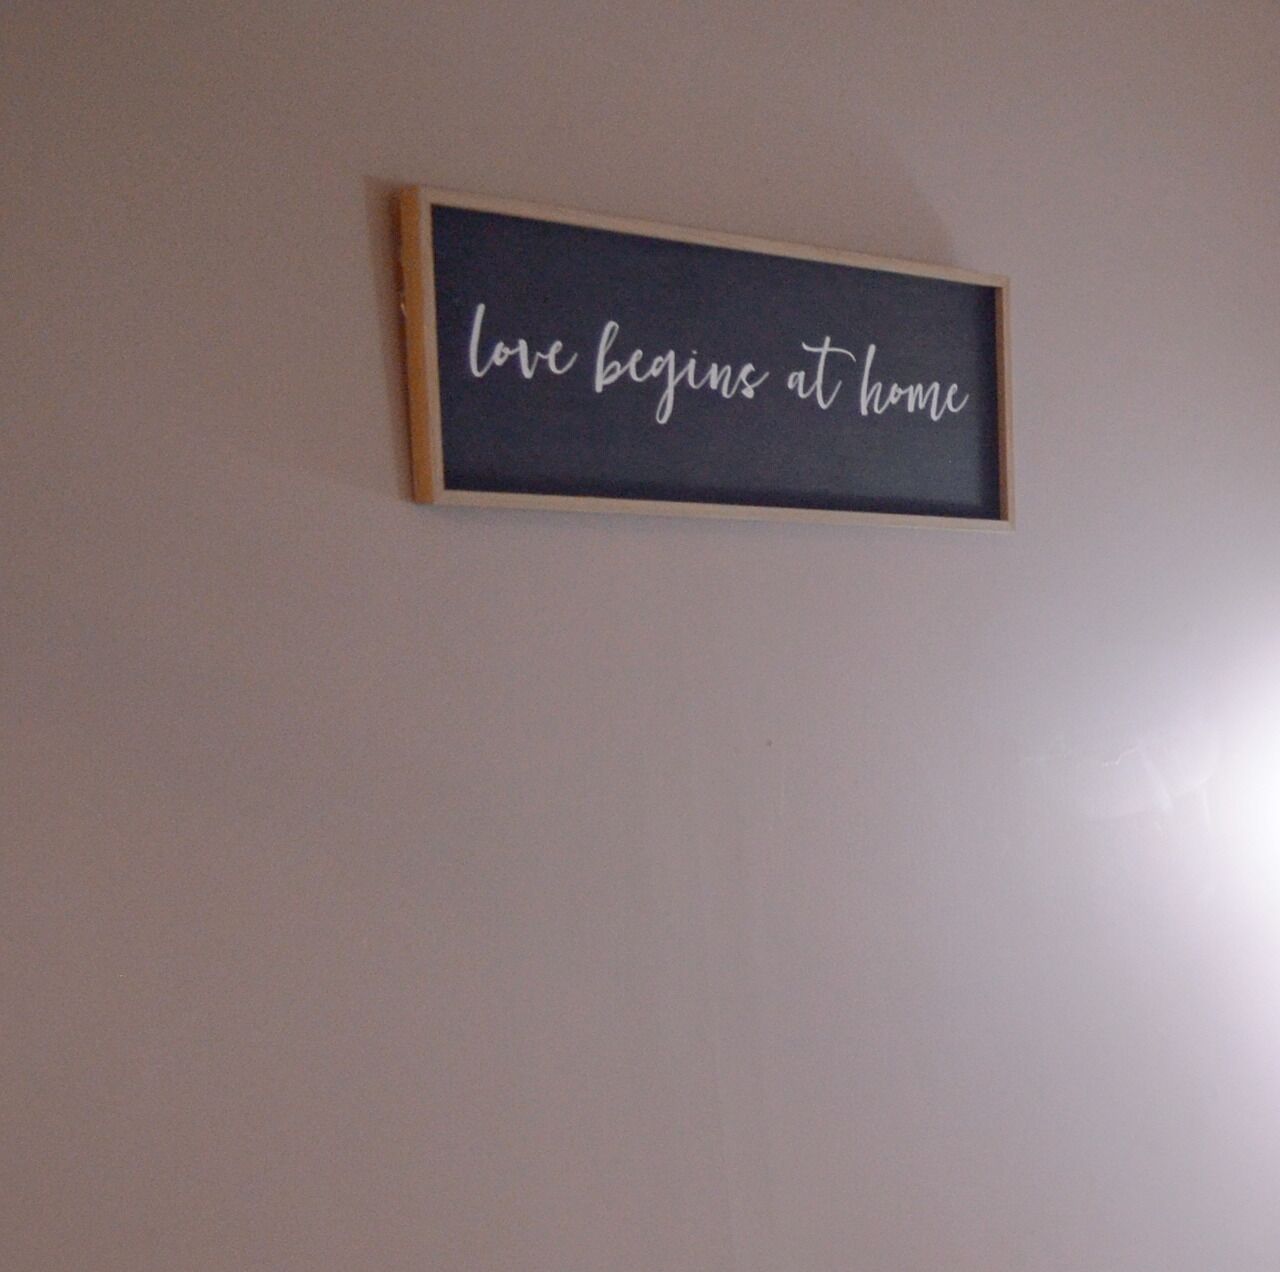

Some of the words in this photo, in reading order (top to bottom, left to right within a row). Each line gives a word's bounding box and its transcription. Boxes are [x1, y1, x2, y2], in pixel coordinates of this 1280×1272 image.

[468, 303, 578, 378] love
[594, 321, 769, 424] begins
[787, 336, 856, 409] at
[859, 344, 969, 421] home
